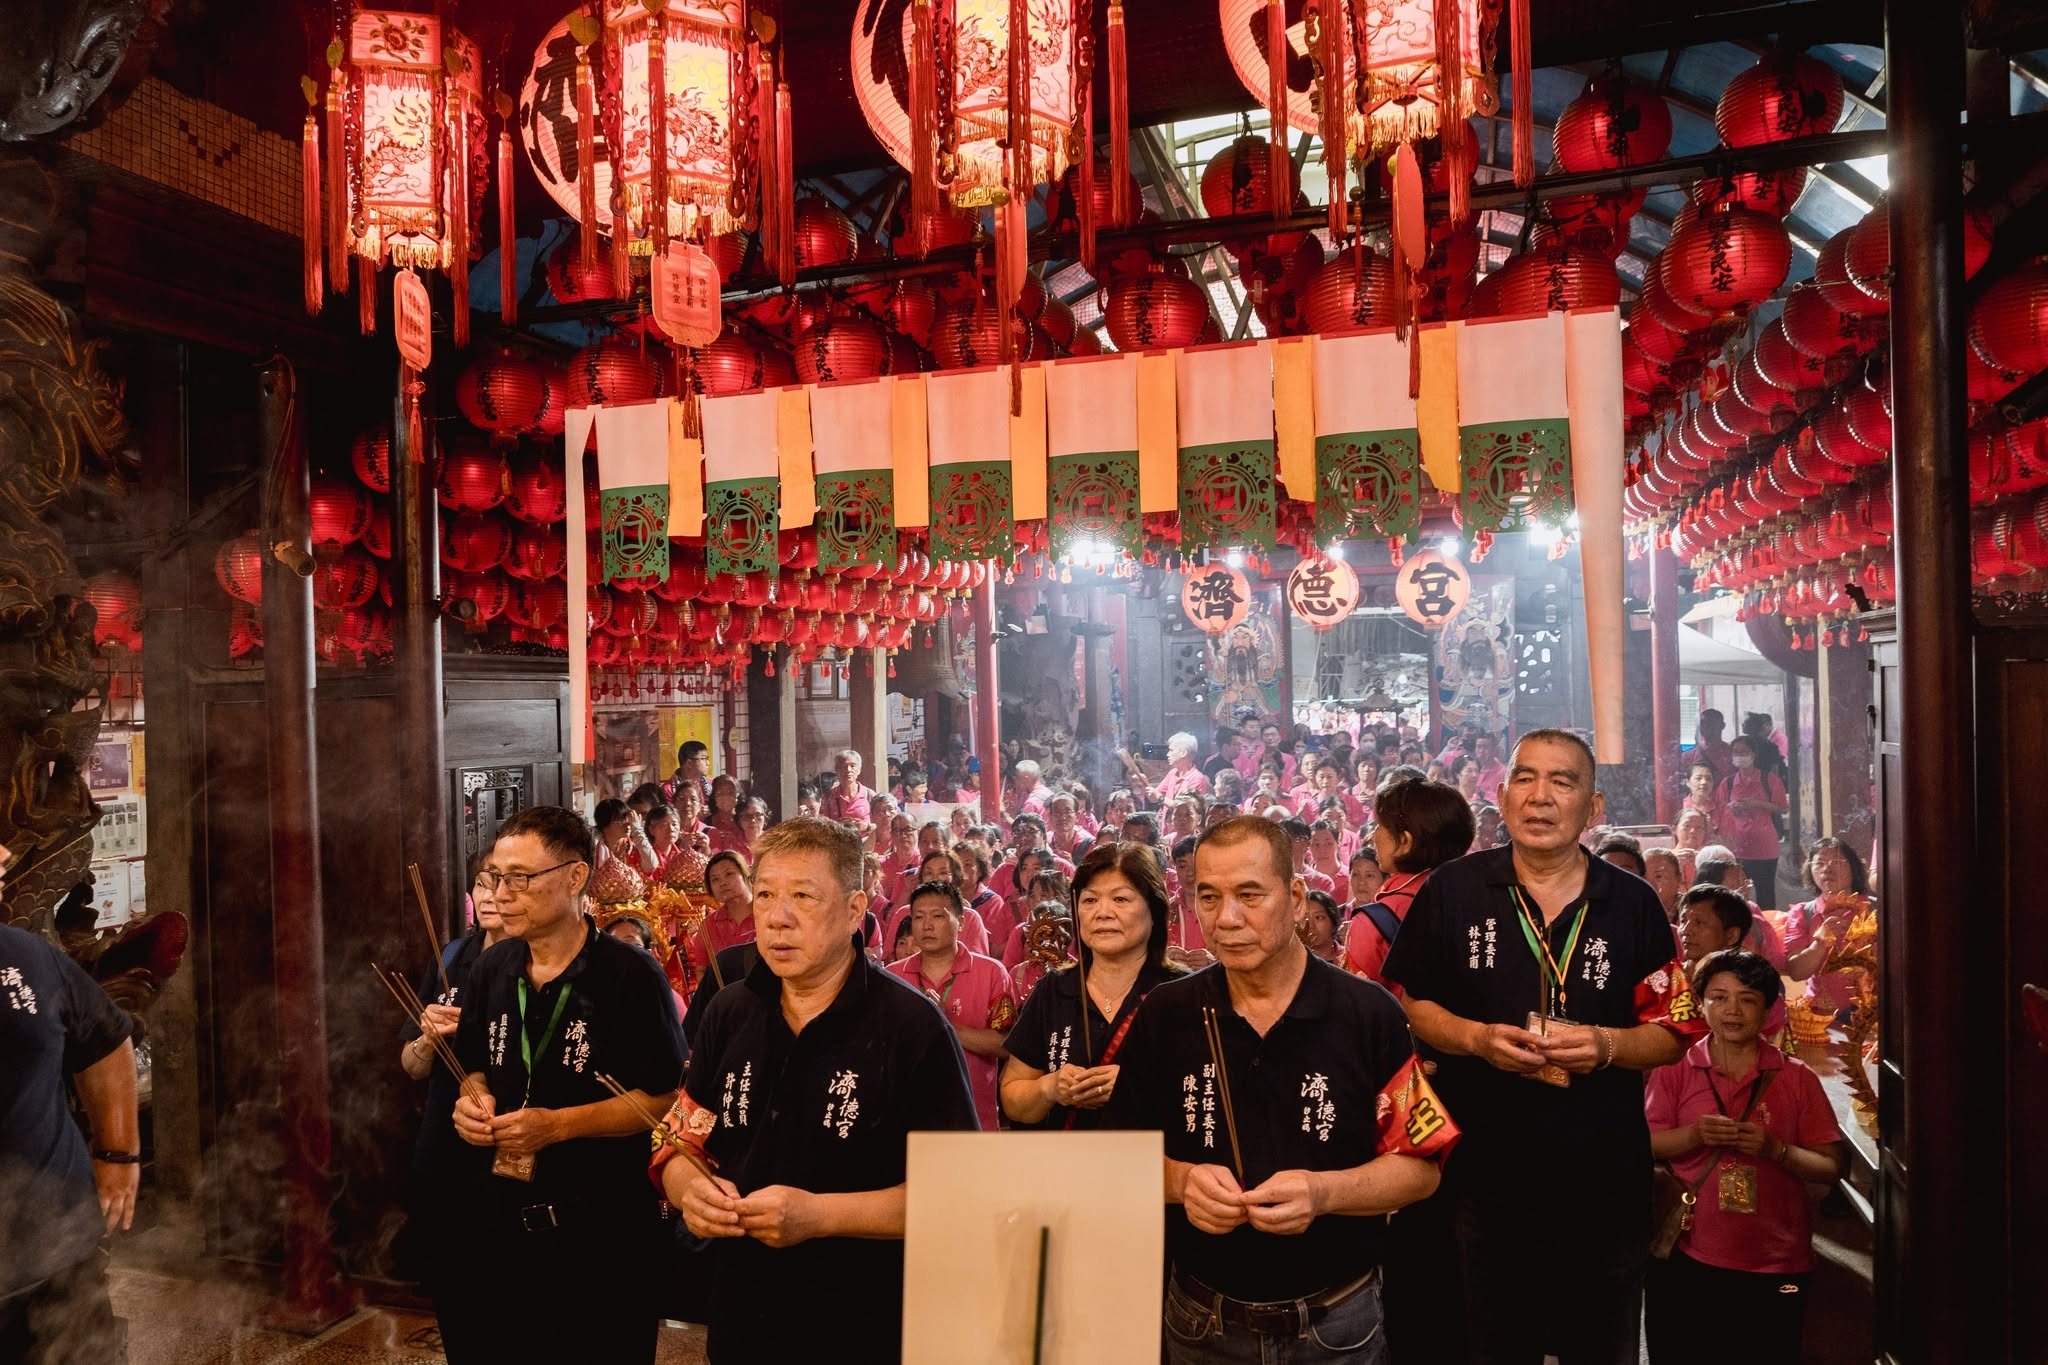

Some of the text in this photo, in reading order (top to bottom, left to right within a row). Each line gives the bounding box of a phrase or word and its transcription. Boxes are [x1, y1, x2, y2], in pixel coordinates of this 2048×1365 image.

[1410, 561, 1460, 617] 宮
[1484, 918, 1498, 969] 管理委員
[1583, 937, 1612, 990] 濟德宮
[564, 1019, 592, 1073] 濟德宮
[736, 1061, 752, 1126] 主任委員
[828, 1069, 860, 1139] 濟德宮
[1183, 1074, 1199, 1133] 陳安男
[1201, 1063, 1216, 1148] 副主任委員
[1300, 1072, 1337, 1142] 濟德宮
